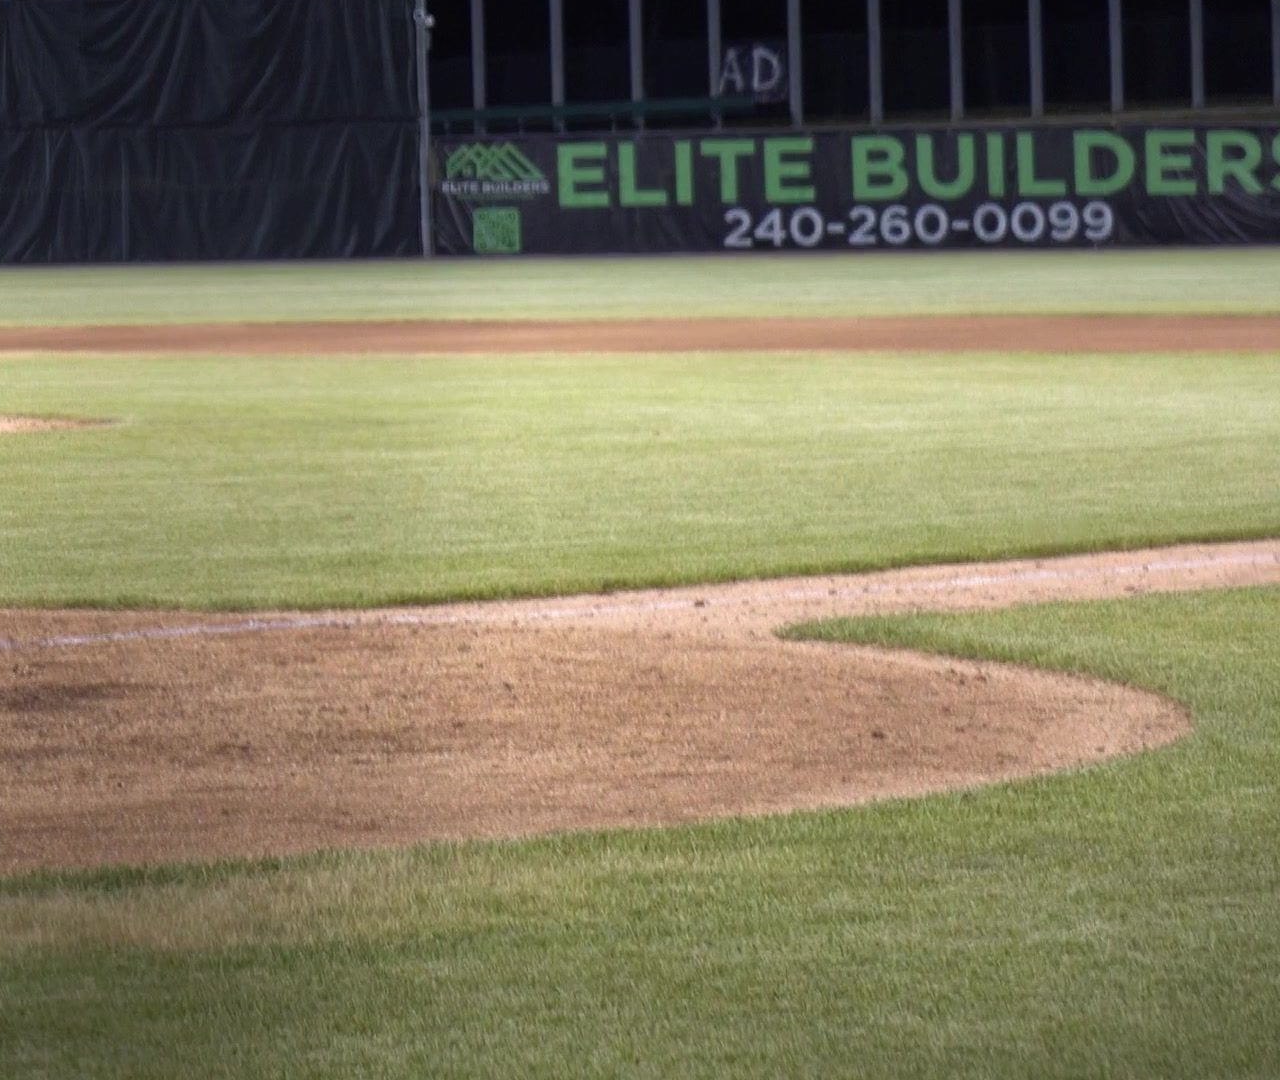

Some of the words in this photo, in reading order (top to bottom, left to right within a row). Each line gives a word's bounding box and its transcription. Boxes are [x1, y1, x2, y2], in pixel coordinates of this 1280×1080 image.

[442, 180, 478, 194] ELITE
[482, 180, 550, 194] BUILDERS
[557, 137, 816, 208] ELITE
[850, 128, 1280, 201] BUILDER
[723, 200, 1113, 248] 240-260-0099
